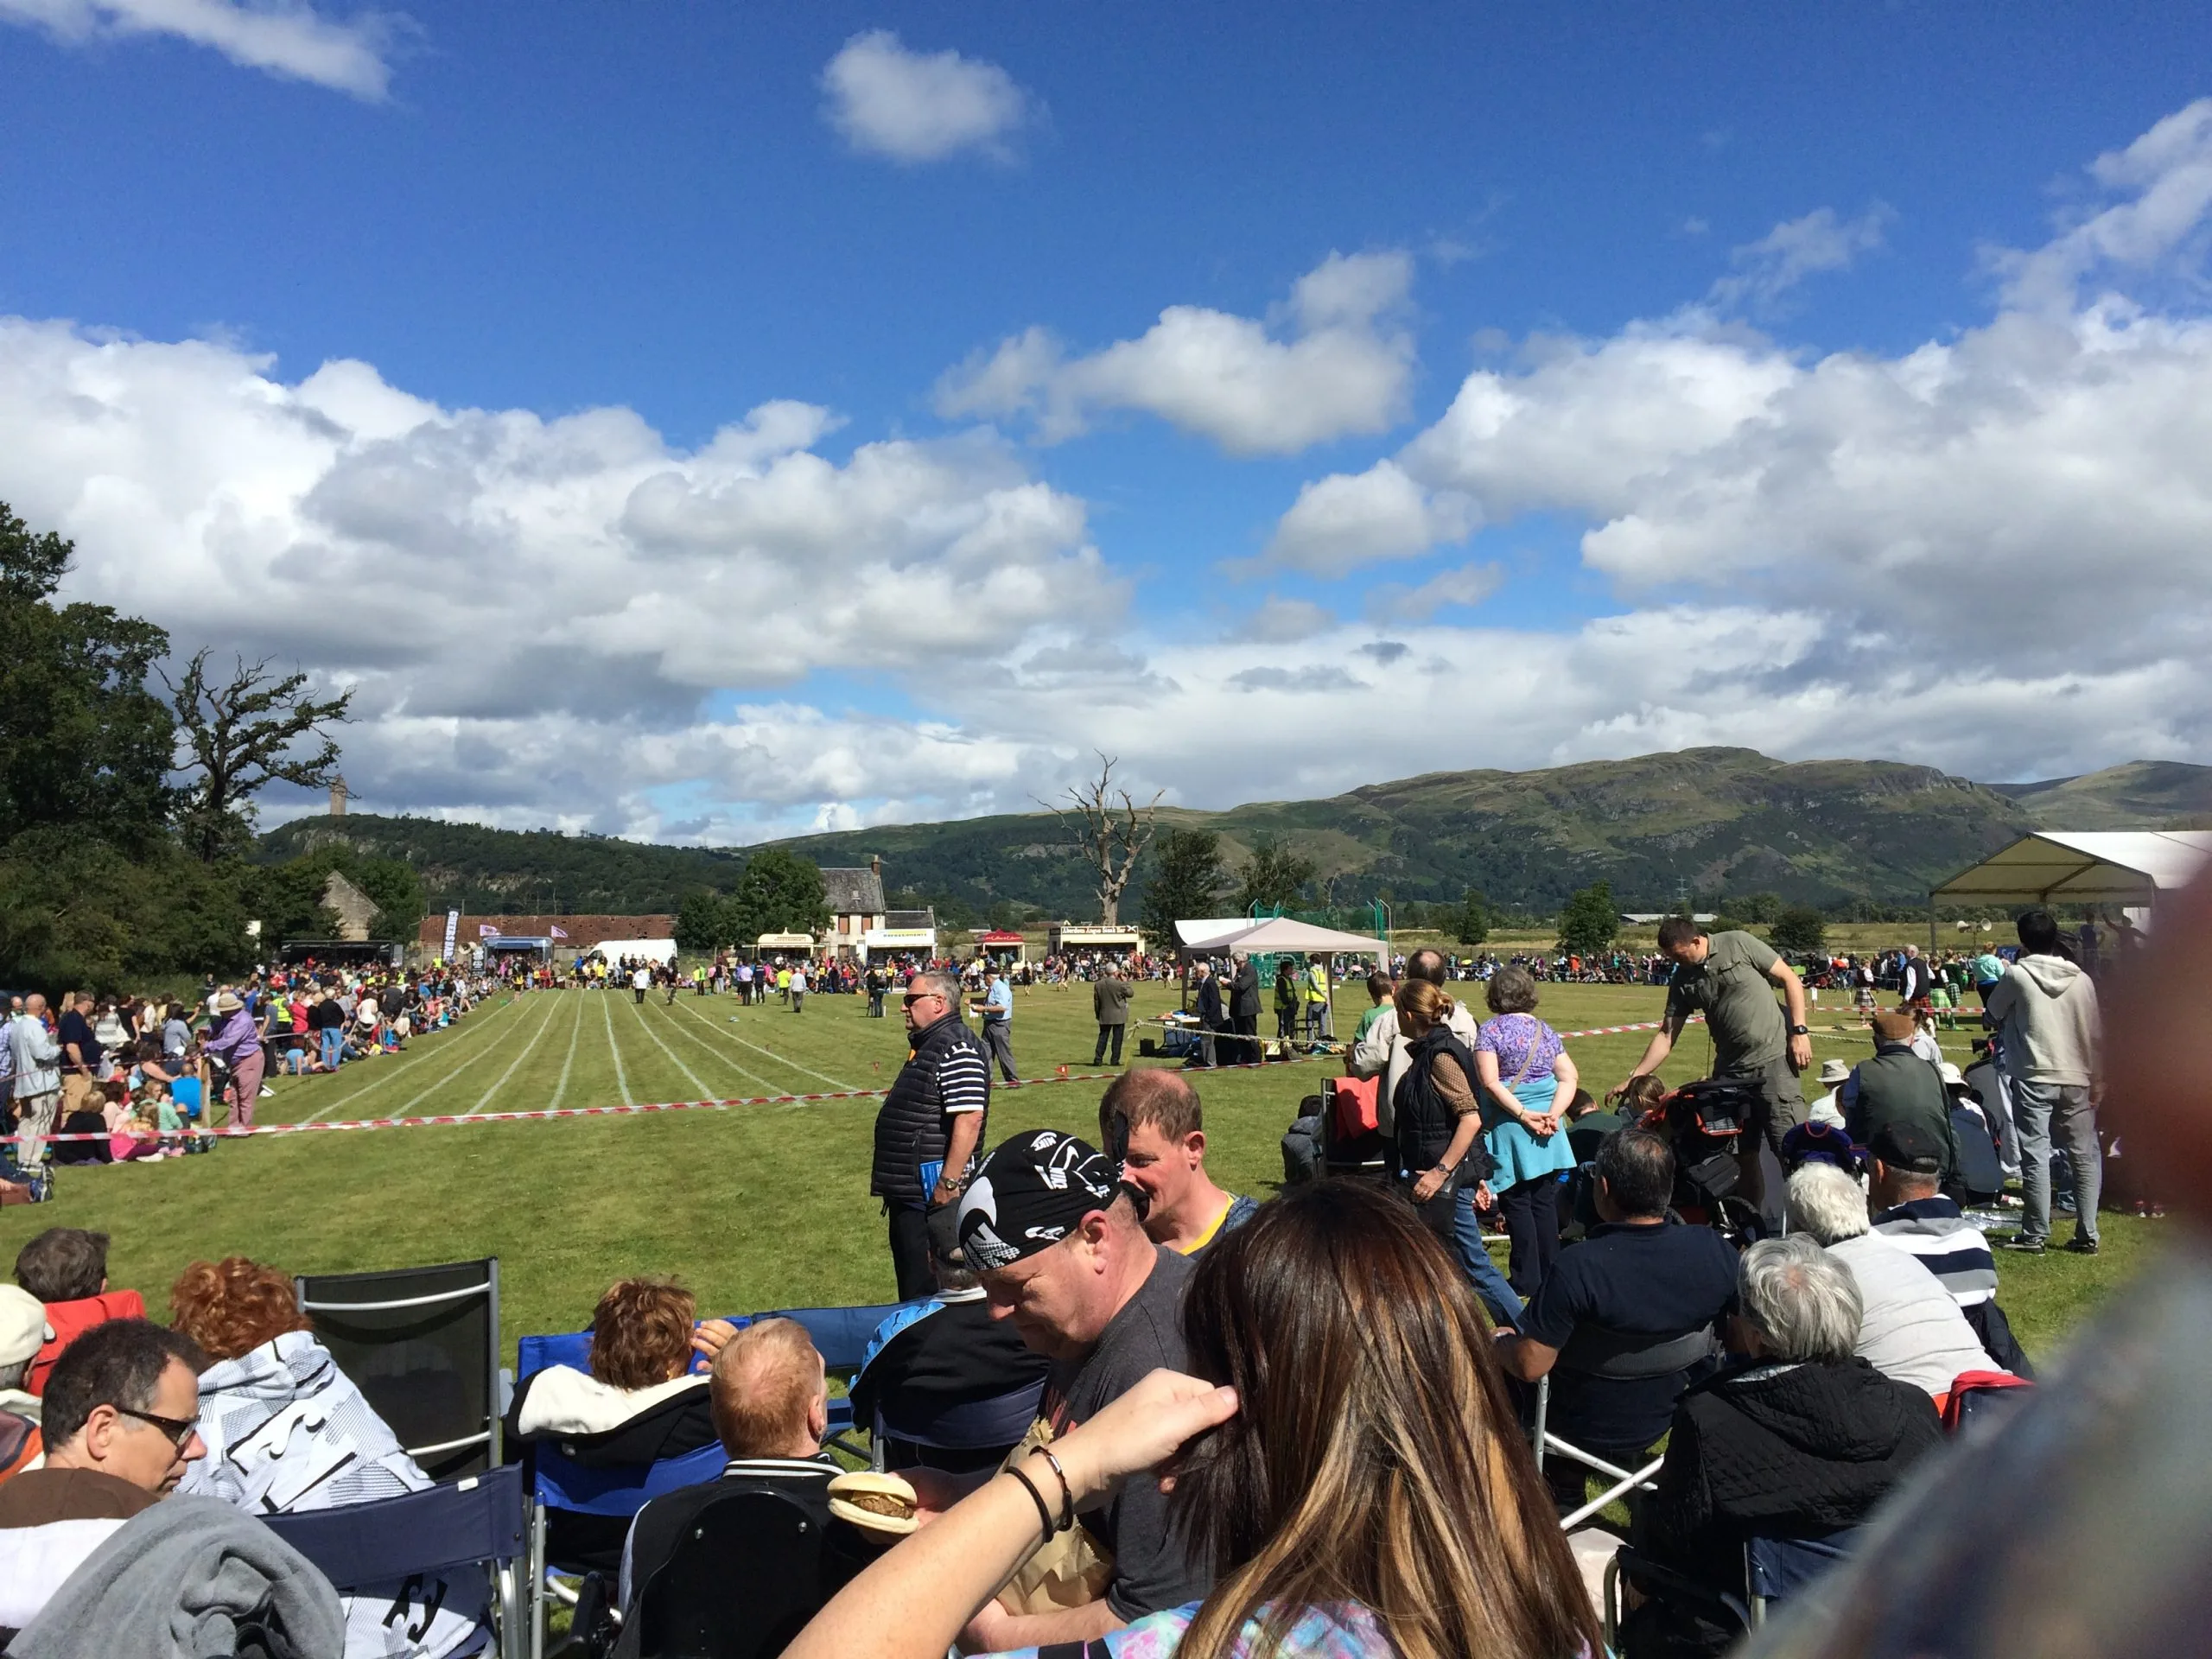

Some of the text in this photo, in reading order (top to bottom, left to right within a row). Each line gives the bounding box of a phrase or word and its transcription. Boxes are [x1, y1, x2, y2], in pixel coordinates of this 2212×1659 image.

[445, 911, 459, 942] CHEERS
[1086, 926, 1102, 936] Angus
[1034, 1136, 1057, 1152] NIKE
